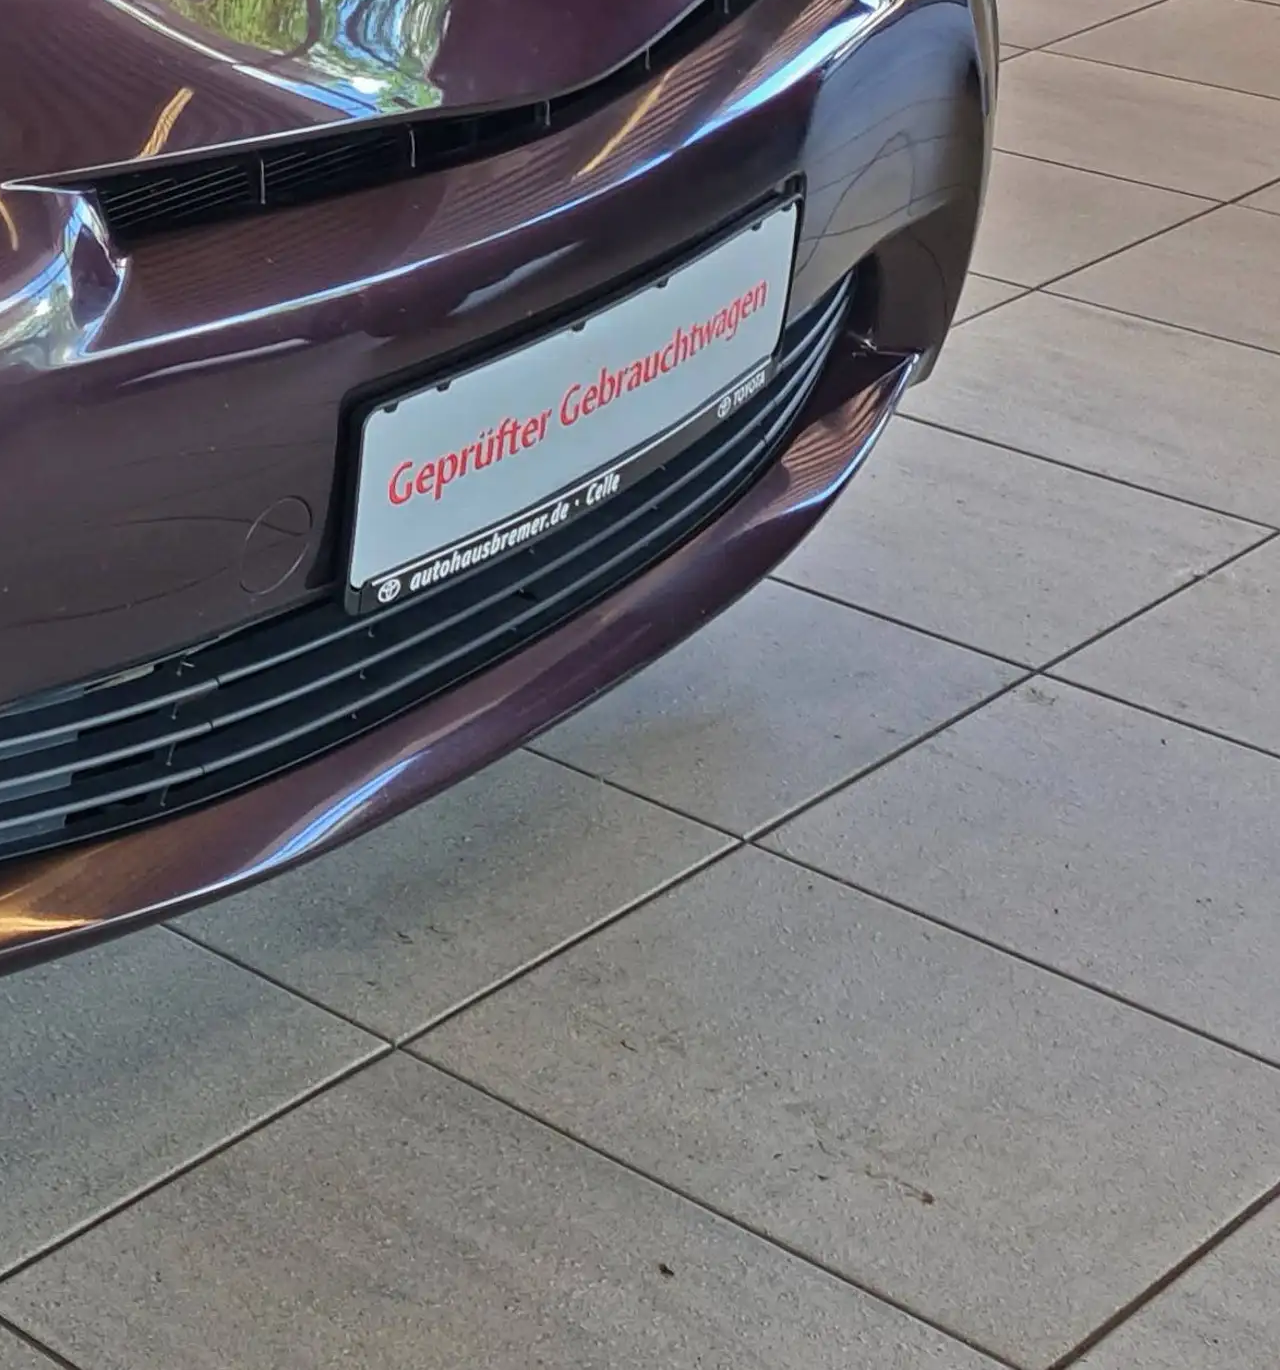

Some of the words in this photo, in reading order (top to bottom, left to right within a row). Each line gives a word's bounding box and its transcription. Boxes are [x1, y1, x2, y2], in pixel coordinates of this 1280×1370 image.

[389, 408, 552, 505] Geprüfter
[560, 280, 768, 426] Gebrauchtwagen
[733, 370, 765, 406] TOYOTA
[410, 501, 570, 591] autohausbremer.de
[586, 473, 620, 505] Celle
